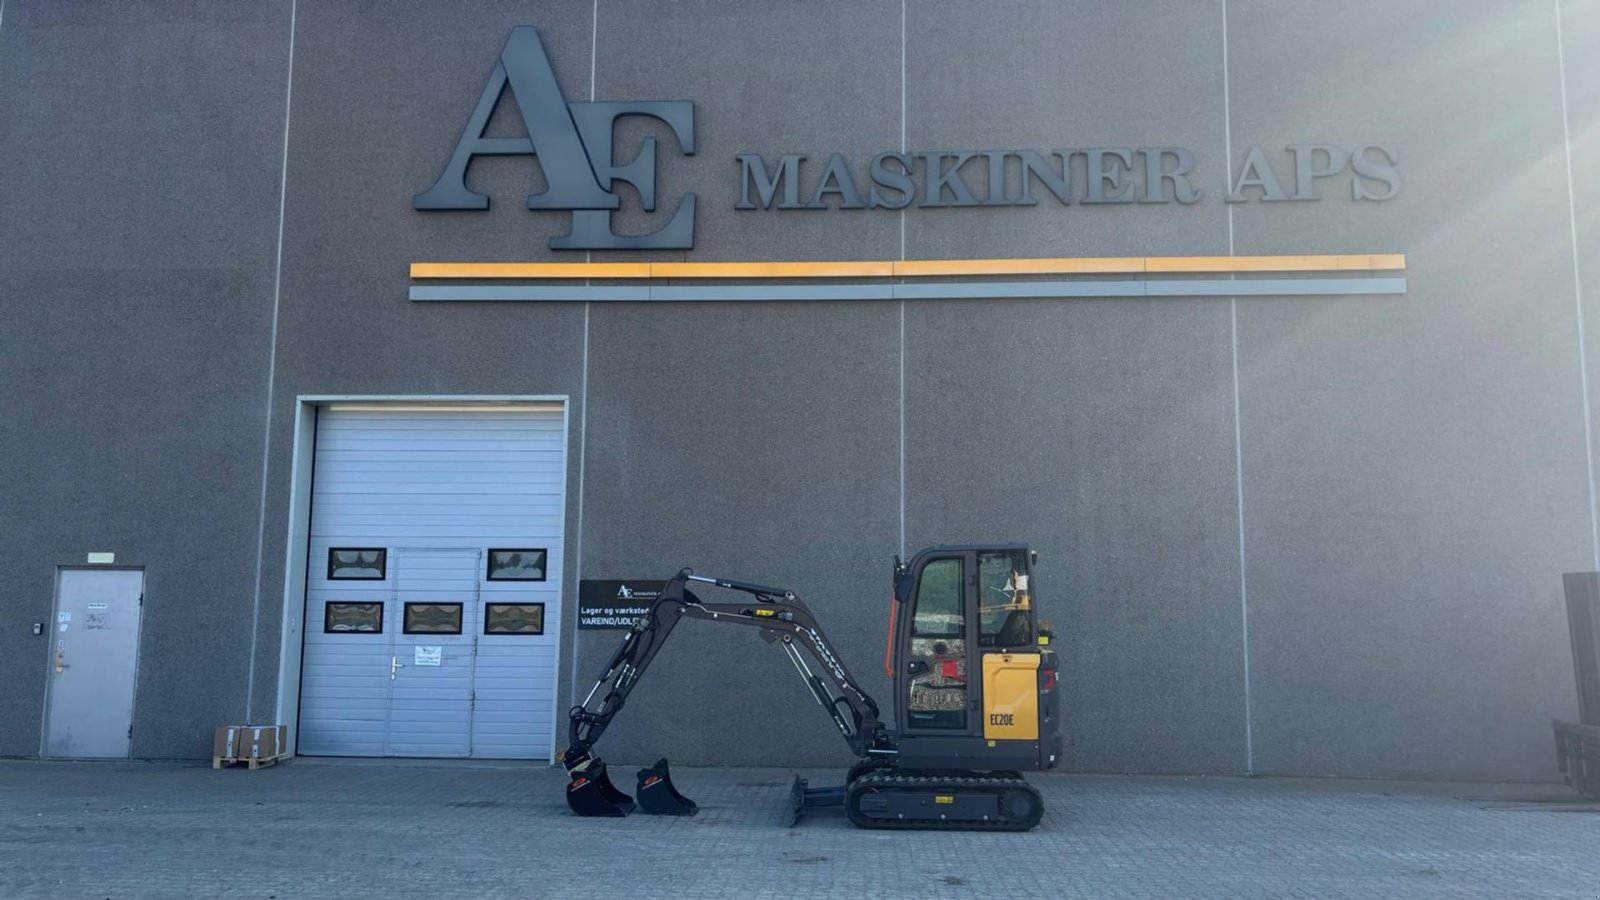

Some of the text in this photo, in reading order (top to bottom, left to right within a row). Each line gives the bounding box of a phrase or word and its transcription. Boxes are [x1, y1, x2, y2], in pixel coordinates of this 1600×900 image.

[413, 25, 1401, 250] AE MASKINER APS
[581, 607, 602, 615] Lager
[990, 714, 1014, 726] EC20E
